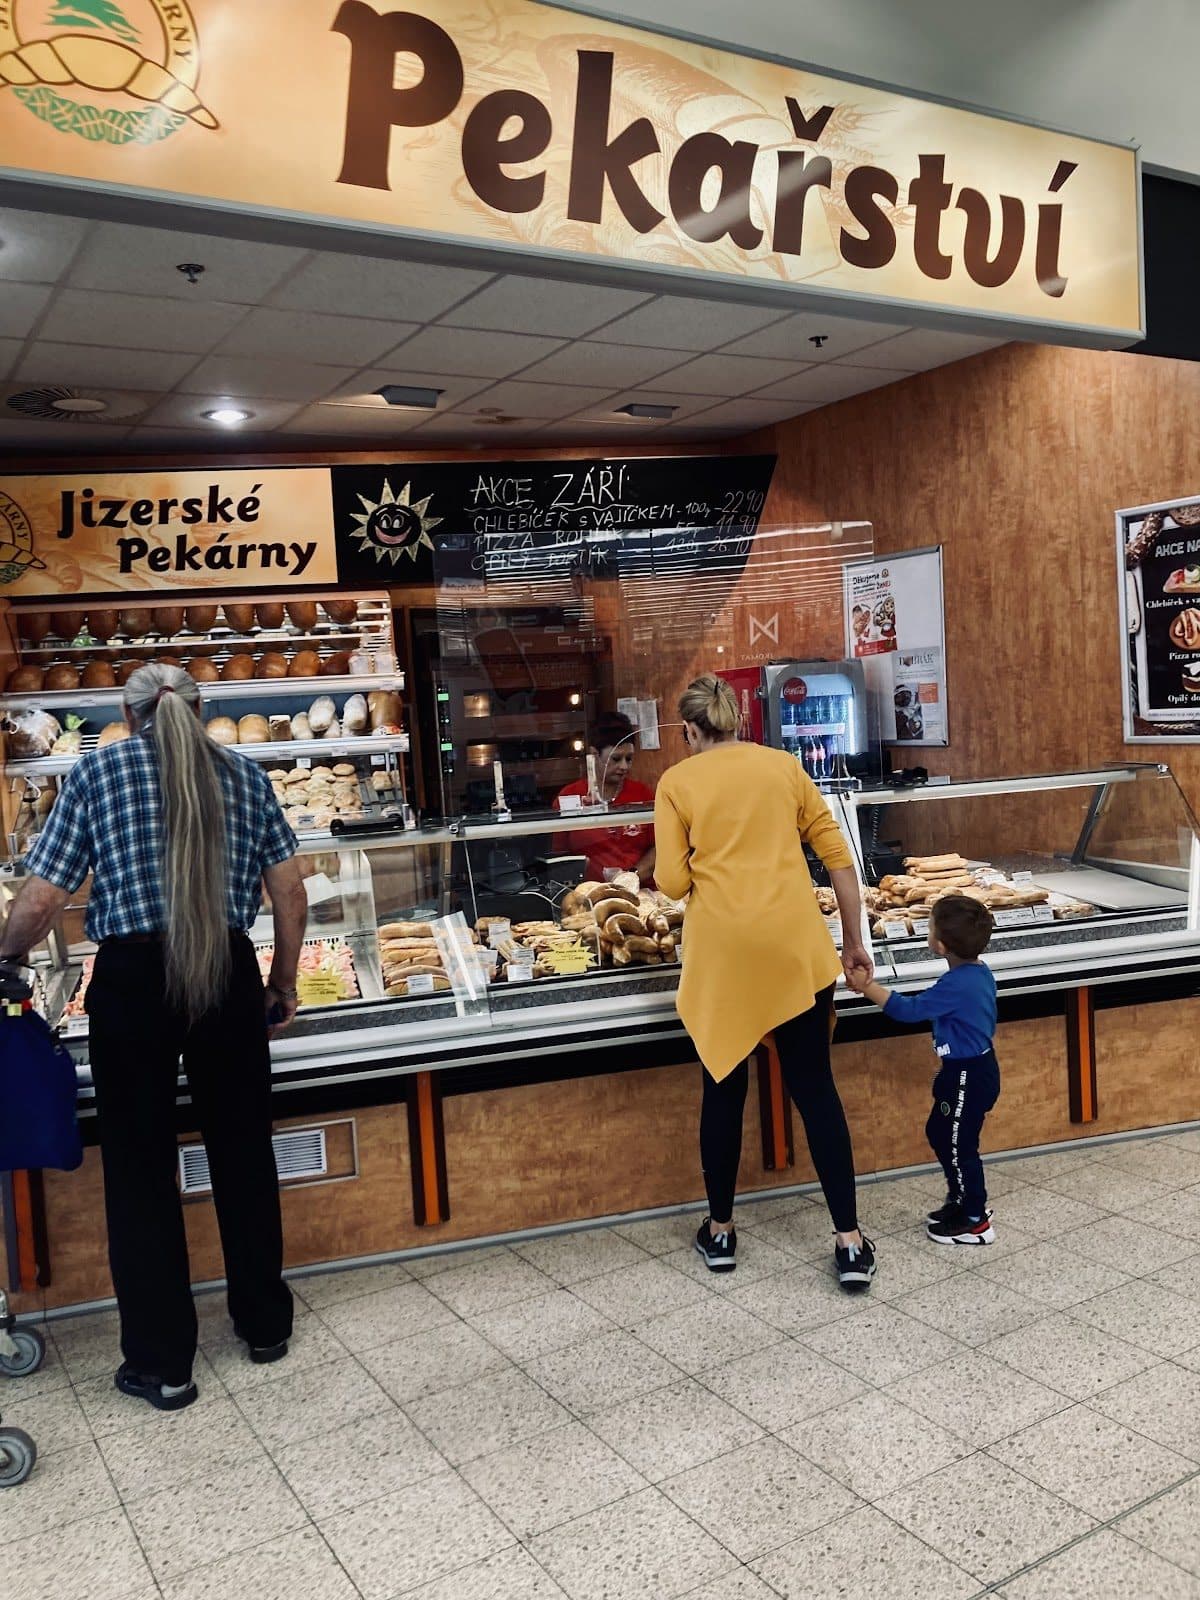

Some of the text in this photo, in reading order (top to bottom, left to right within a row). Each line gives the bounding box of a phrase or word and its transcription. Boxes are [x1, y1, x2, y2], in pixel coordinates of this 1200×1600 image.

[331, 0, 1078, 298] Pekařství
[470, 464, 627, 507] AKCE ZÁŘÍ
[57, 483, 263, 539] Jizerské
[473, 507, 570, 534] CHLEBÍČEK
[592, 503, 675, 526] VAJÍČKEM
[116, 533, 318, 575] Pekárny
[473, 532, 535, 553] PIZZA
[1155, 541, 1185, 557] AKCE
[1169, 652, 1190, 660] Pizza
[1167, 693, 1190, 705] Opilý
